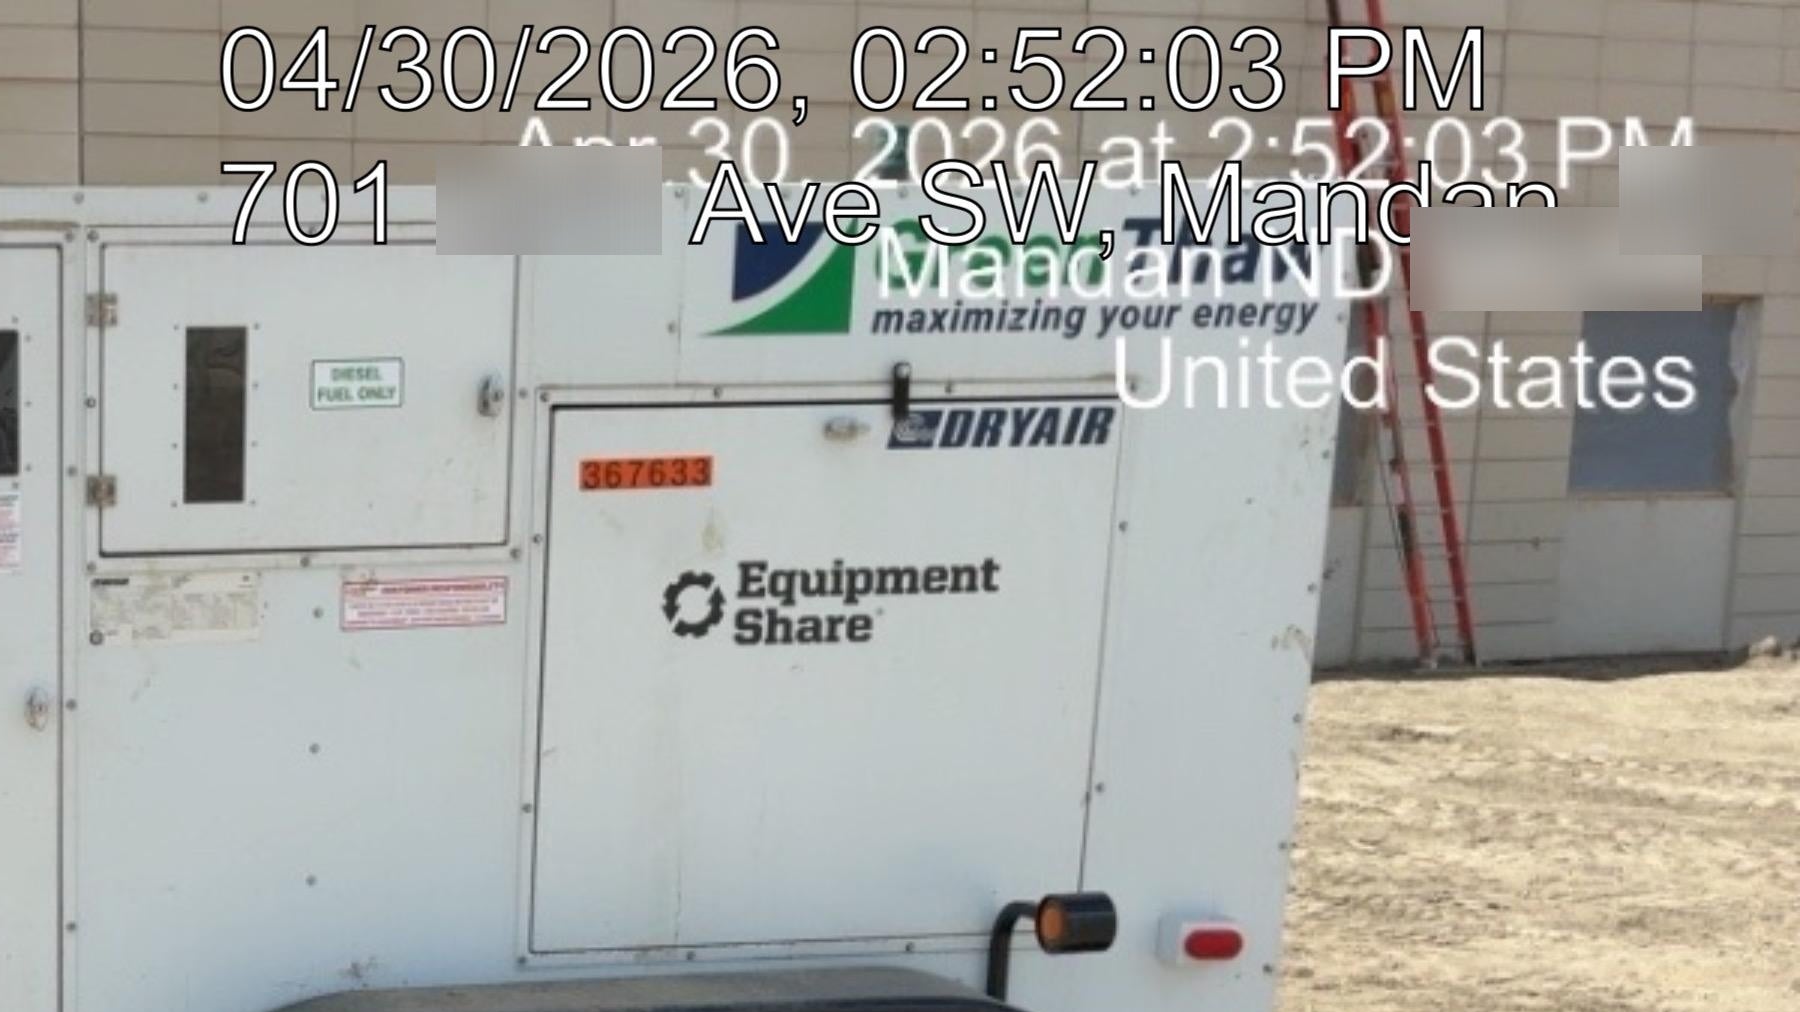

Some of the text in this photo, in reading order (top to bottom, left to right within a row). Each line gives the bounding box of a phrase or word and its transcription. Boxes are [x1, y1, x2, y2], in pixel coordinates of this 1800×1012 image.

[875, 218, 1110, 289] Geen
[871, 298, 1319, 339] maximizing your energy
[318, 385, 397, 402] FUEL ONLY
[331, 366, 383, 383] DIESEL
[938, 406, 1117, 450] DRYAIR
[582, 457, 709, 490] 367633
[736, 557, 1001, 607] Equipment
[734, 608, 874, 646] Share
